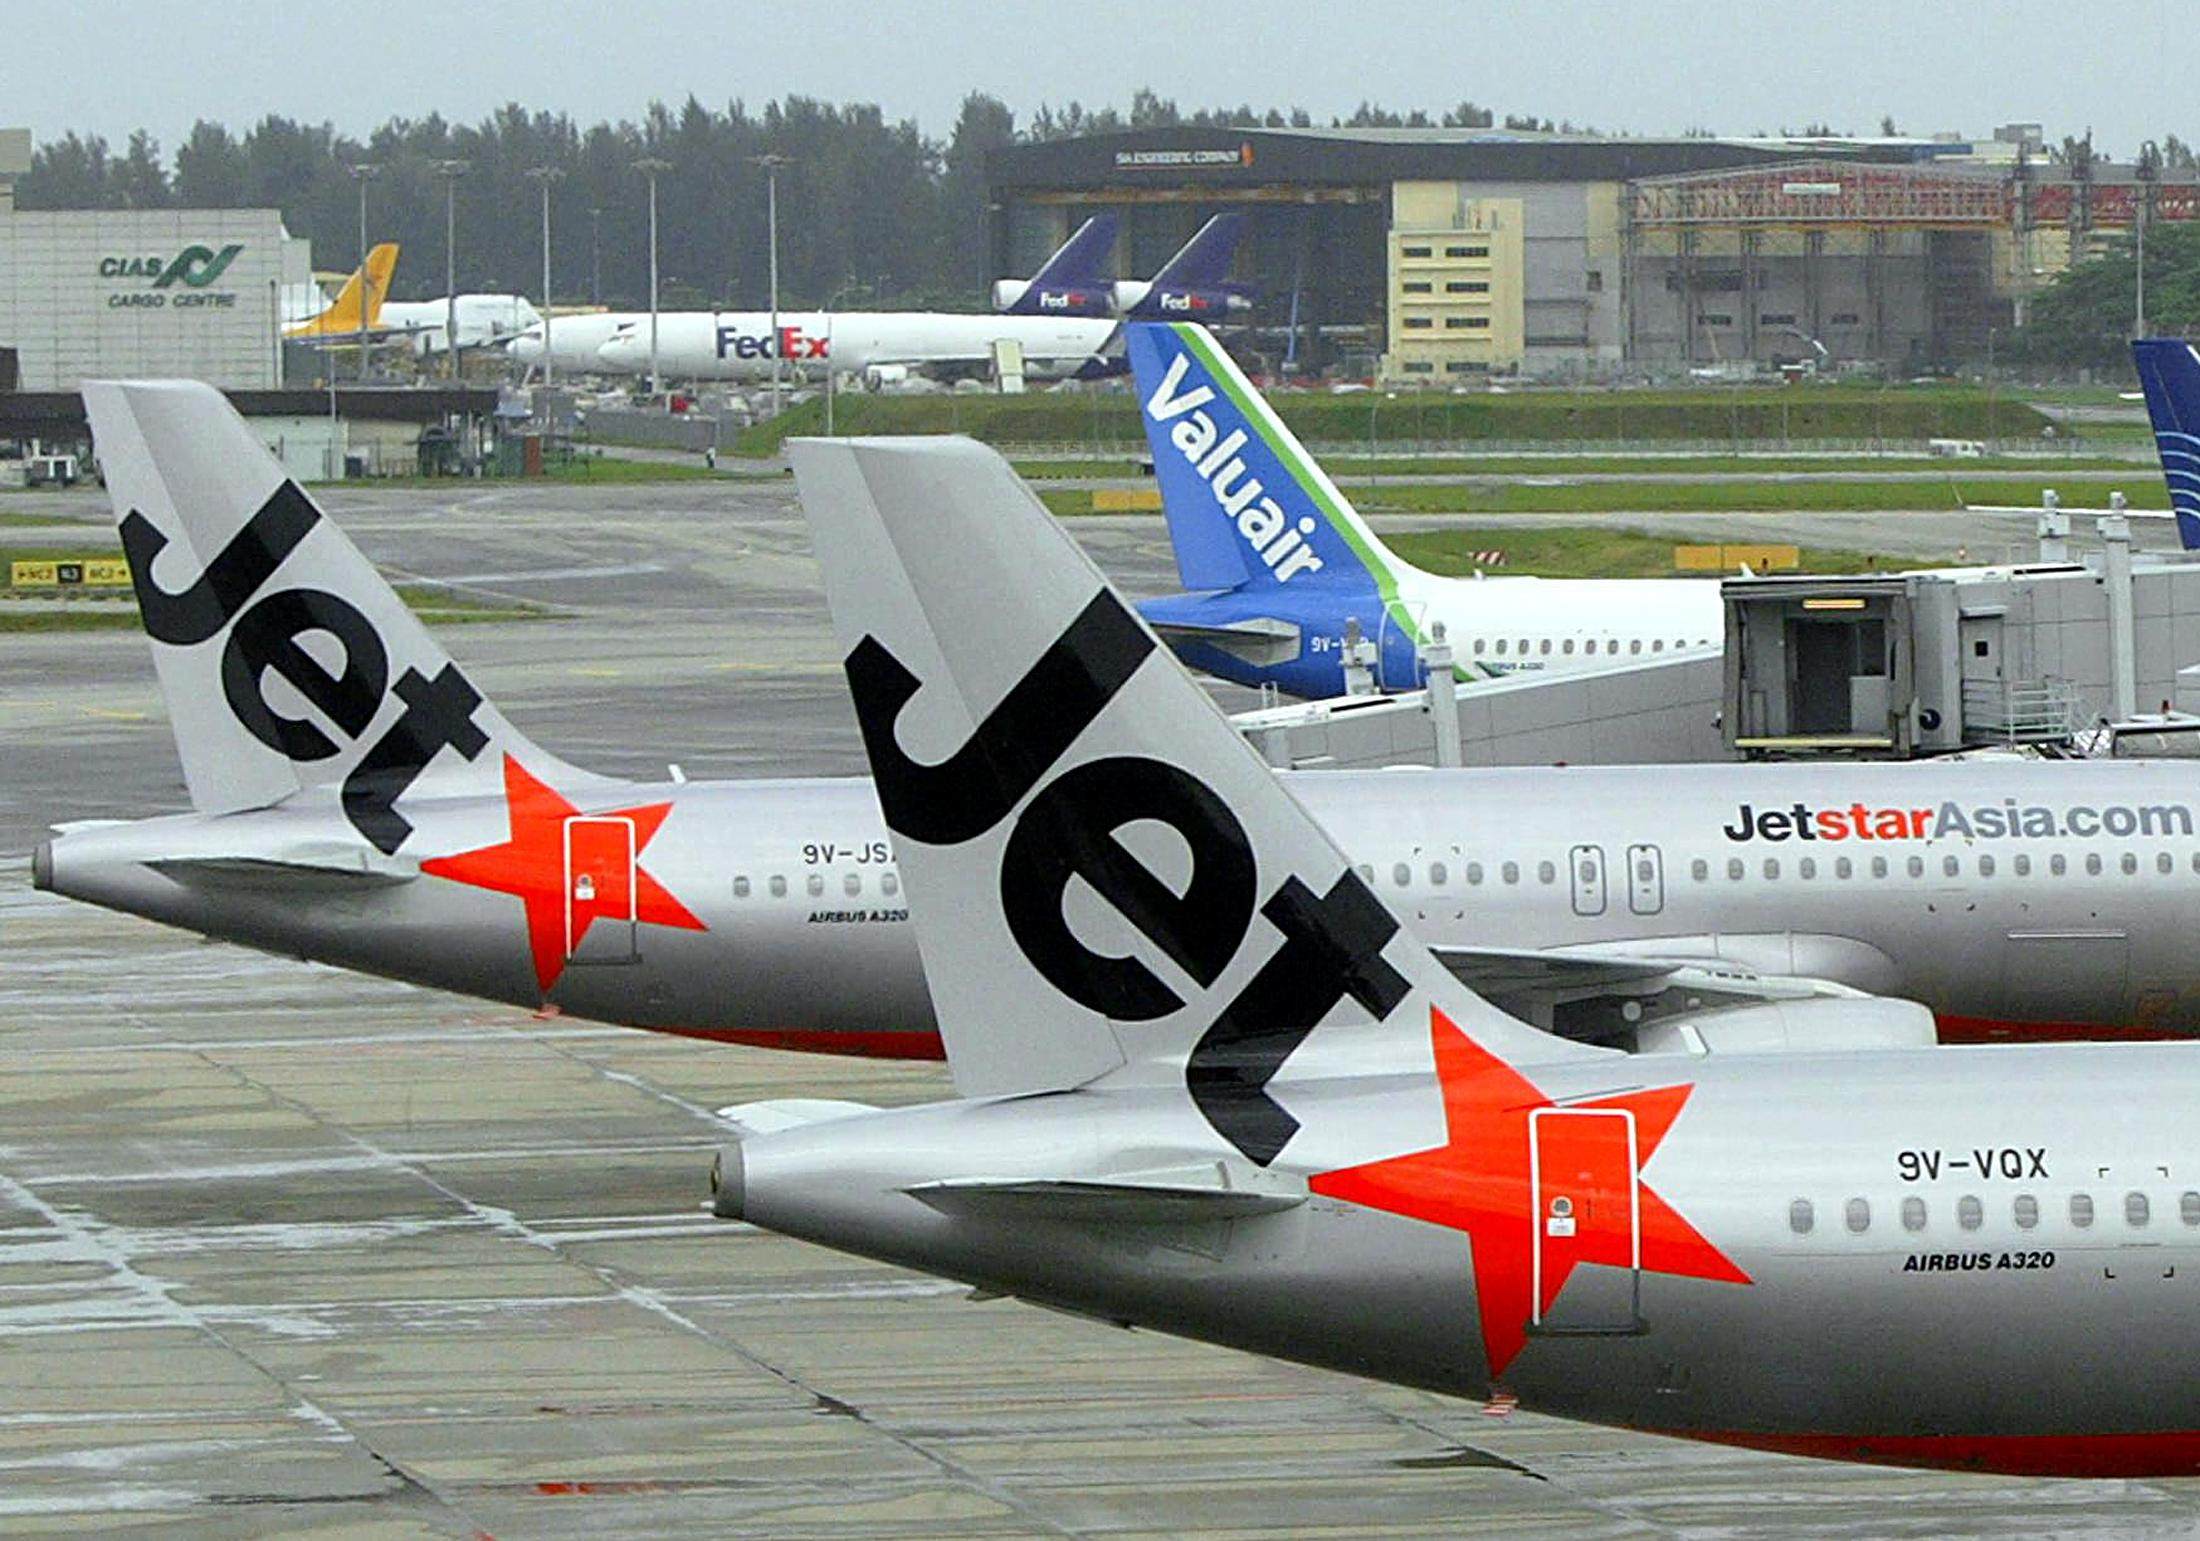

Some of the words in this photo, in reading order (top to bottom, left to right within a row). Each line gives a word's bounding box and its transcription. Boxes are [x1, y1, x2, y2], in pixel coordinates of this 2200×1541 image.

[100, 257, 163, 277] CIAS
[109, 293, 166, 308] CARGO
[173, 293, 237, 308] CENTRE
[717, 326, 830, 359] FedEx
[1147, 351, 1324, 583] Valuair
[118, 478, 491, 857] Jet
[1723, 799, 2195, 843] JetstarAsia.com
[803, 843, 896, 865] 9V-JS
[843, 585, 1414, 1168] Jet
[808, 910, 867, 923] AIRBUS
[869, 909, 909, 922] A320
[1898, 1149, 2049, 1182] 9V-VQX
[1902, 1252, 1992, 1272] AIRBUS
[1996, 1251, 2056, 1270] A320
